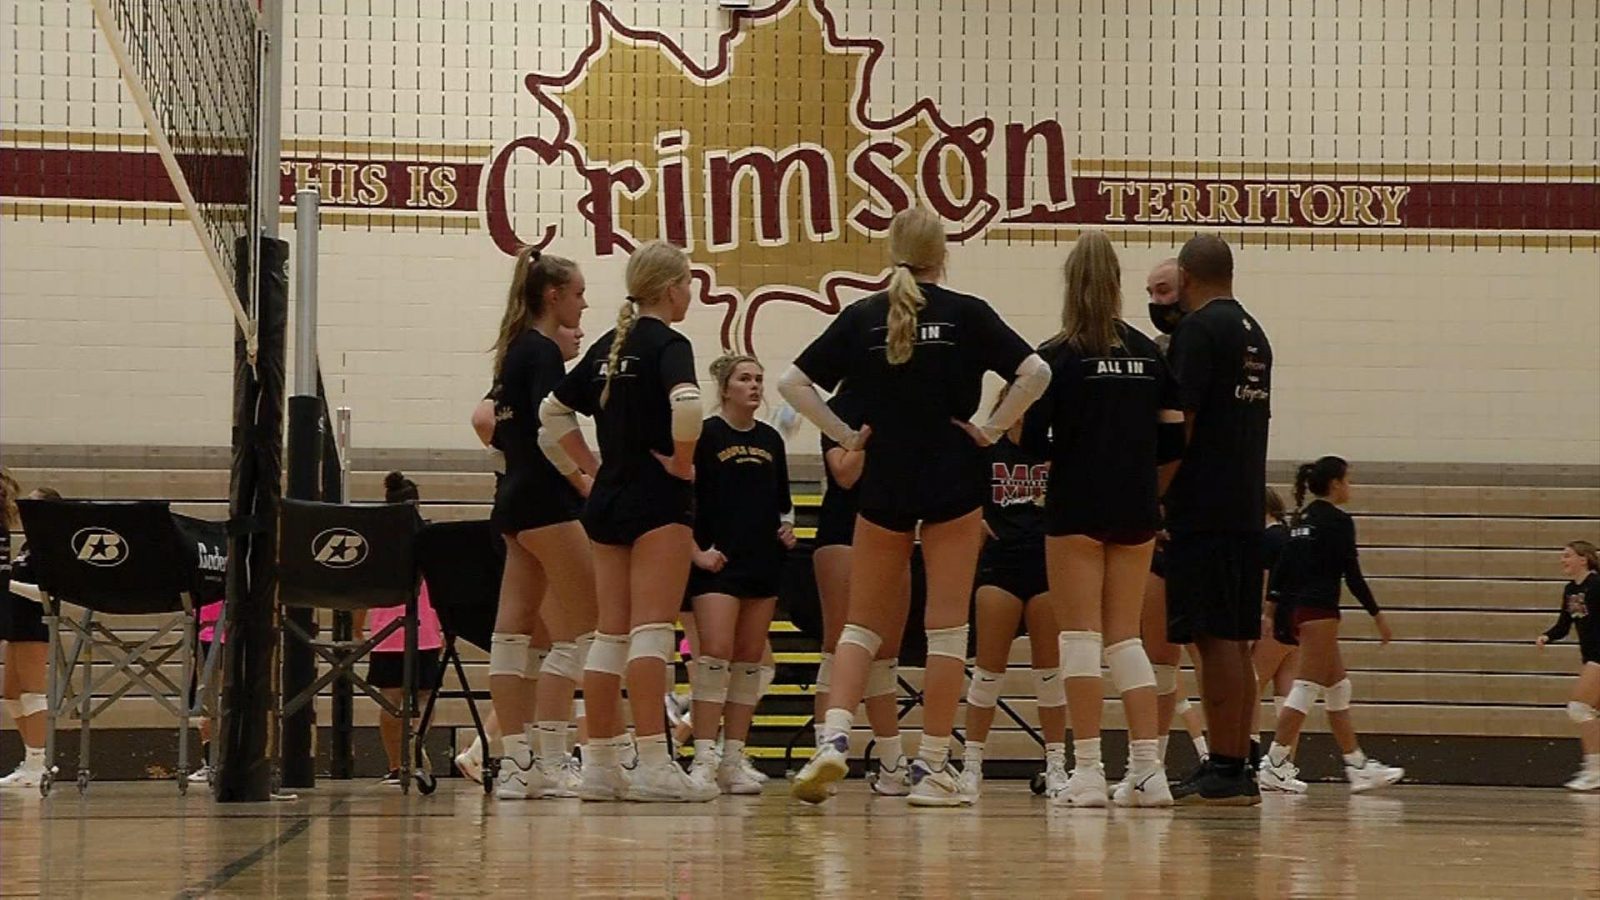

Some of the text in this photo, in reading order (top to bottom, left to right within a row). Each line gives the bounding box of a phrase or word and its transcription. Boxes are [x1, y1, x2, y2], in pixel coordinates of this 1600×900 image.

[406, 165, 458, 208] IS
[484, 117, 1076, 256] Crimson
[1097, 180, 1411, 227] TERRITORY
[921, 325, 941, 340] IN
[1096, 360, 1144, 374] ALL IN
